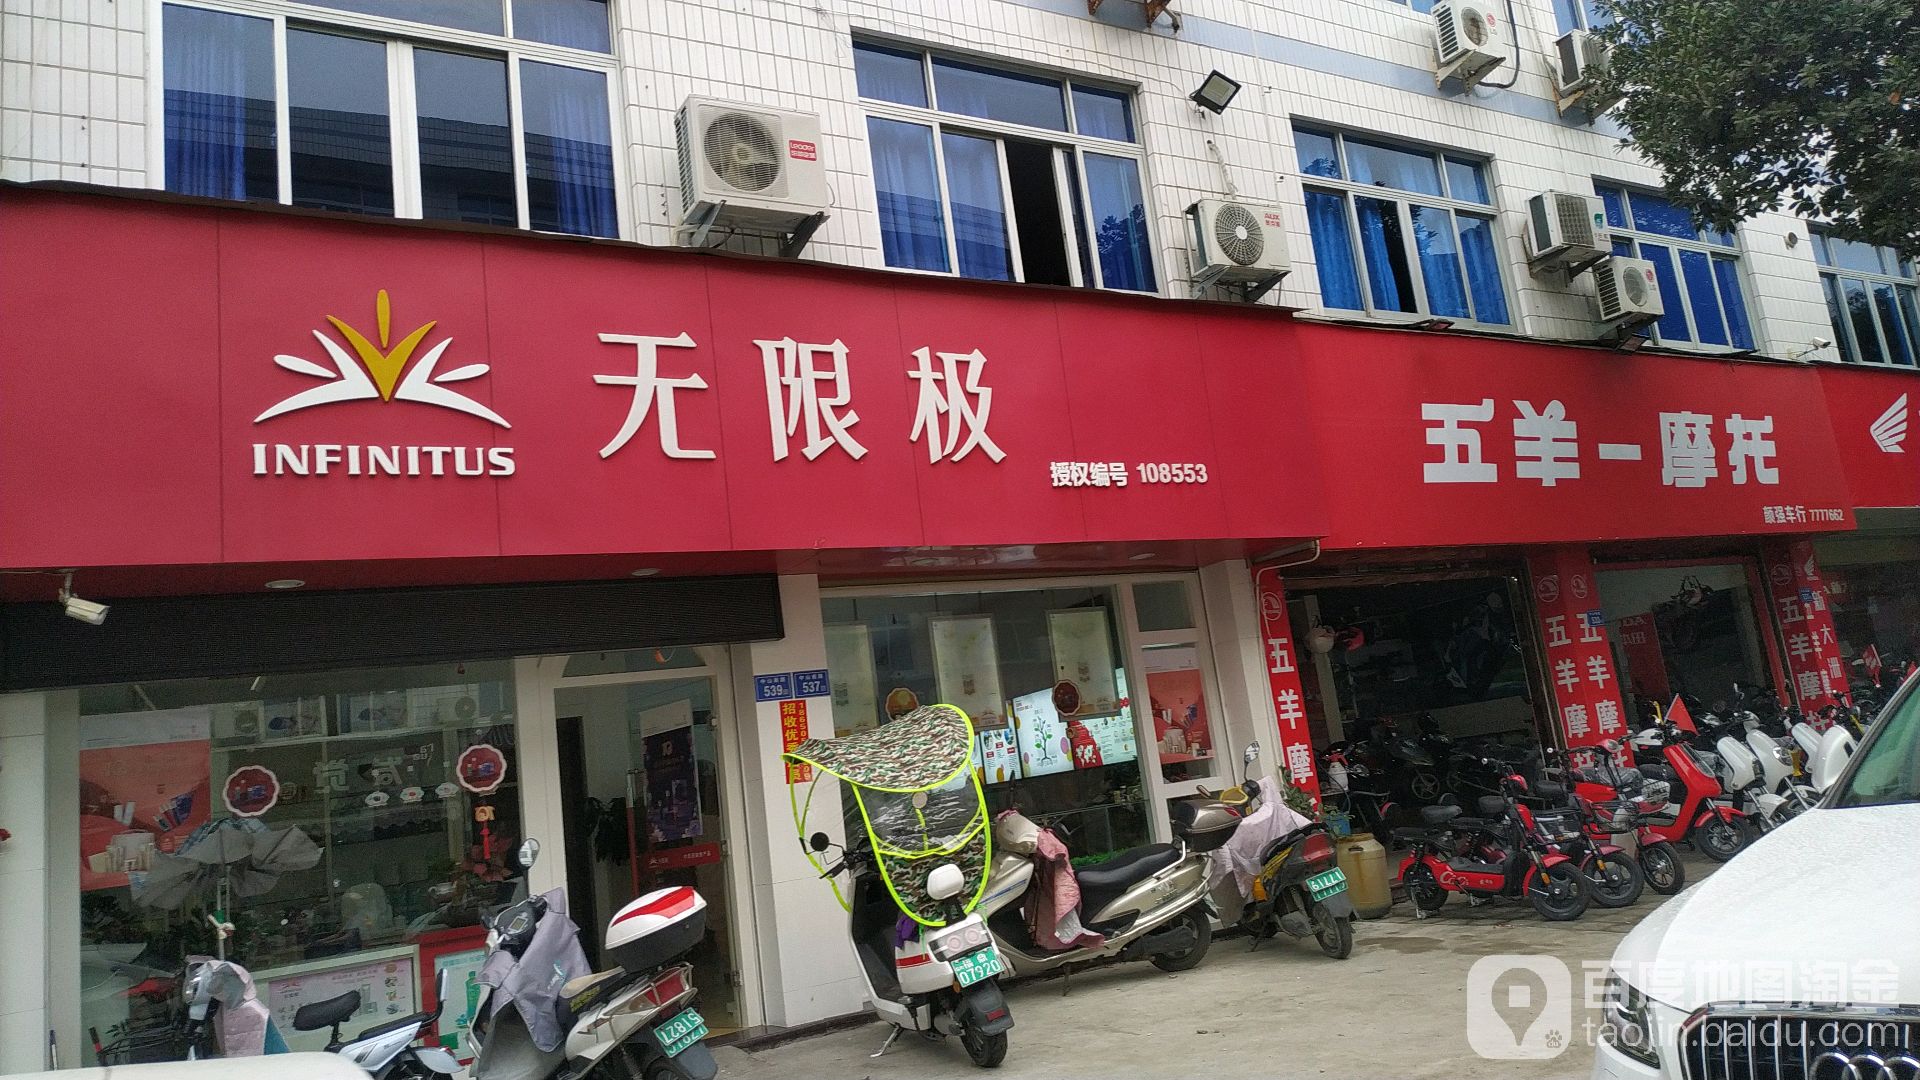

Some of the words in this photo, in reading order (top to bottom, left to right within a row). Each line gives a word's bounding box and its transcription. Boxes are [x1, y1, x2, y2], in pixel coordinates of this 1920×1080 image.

[593, 330, 1007, 464] 无限极
[252, 443, 517, 477] INFINITUS
[1049, 461, 1129, 487] 授权编号
[1136, 462, 1208, 484] 108553
[959, 959, 1002, 985] 07920
[660, 1012, 701, 1044] 51827
